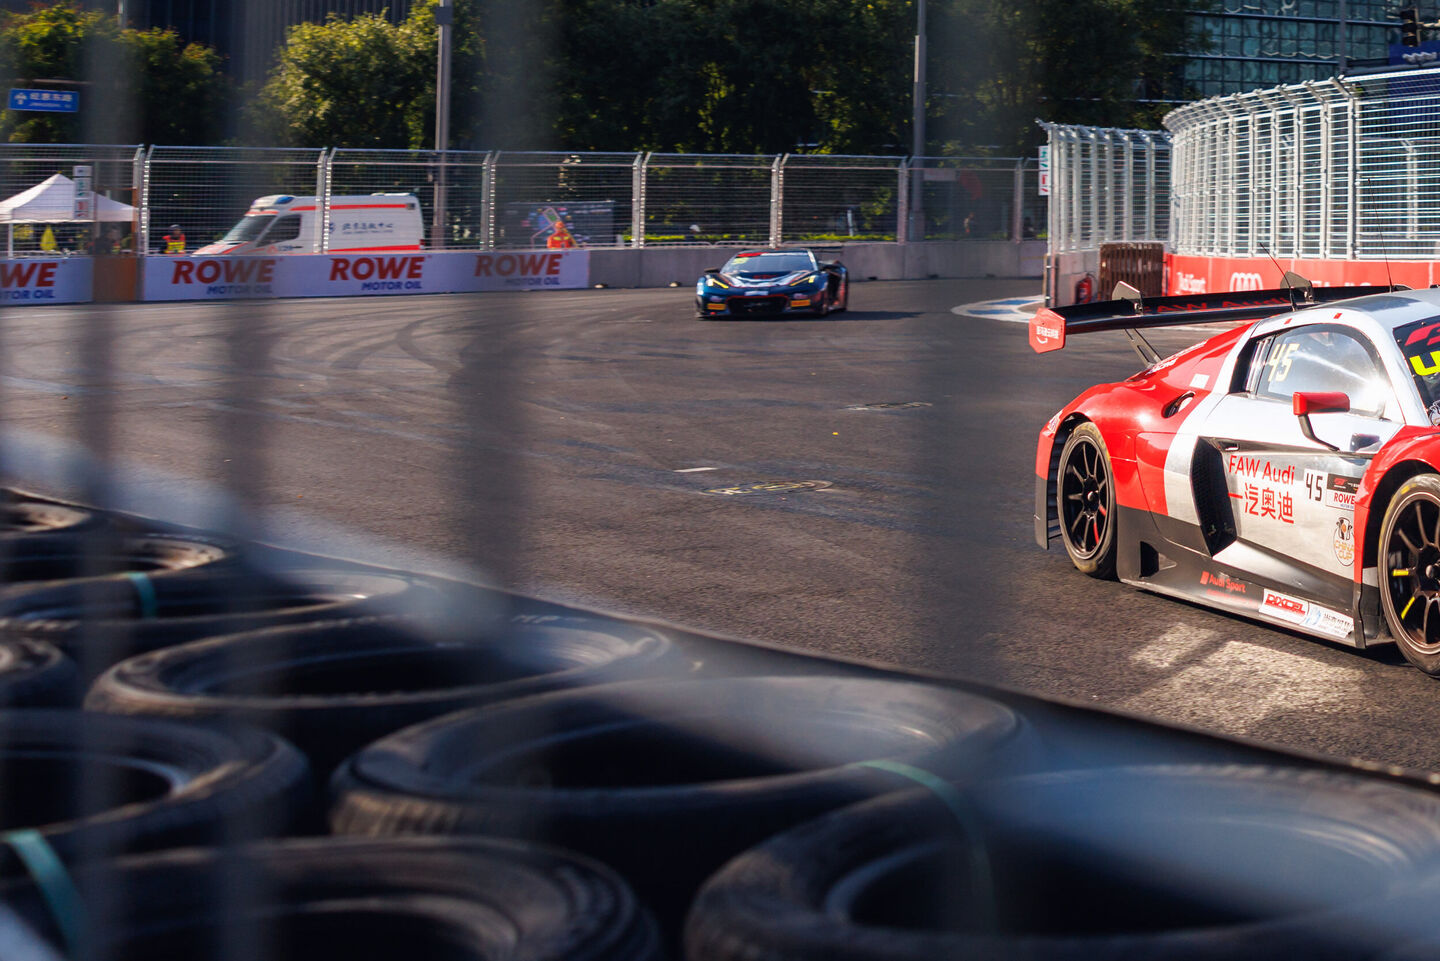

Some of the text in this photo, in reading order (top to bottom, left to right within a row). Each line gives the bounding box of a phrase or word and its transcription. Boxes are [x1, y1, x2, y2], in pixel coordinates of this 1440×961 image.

[0, 262, 58, 287] WE
[172, 259, 276, 284] ROWE
[329, 257, 425, 280] ROWE
[474, 254, 562, 276] ROWE
[207, 285, 251, 295] MOTOR
[362, 280, 422, 290] MOTOR OIL
[544, 277, 560, 285] OIL
[0, 289, 54, 300] TOR OIL
[1268, 343, 1300, 382] 45
[1229, 455, 1295, 485] FAW Audi
[1306, 472, 1323, 502] 45
[1334, 491, 1355, 505] ROWE
[1228, 482, 1295, 524] 一汽奥迪
[1209, 574, 1247, 594] Audi Sport
